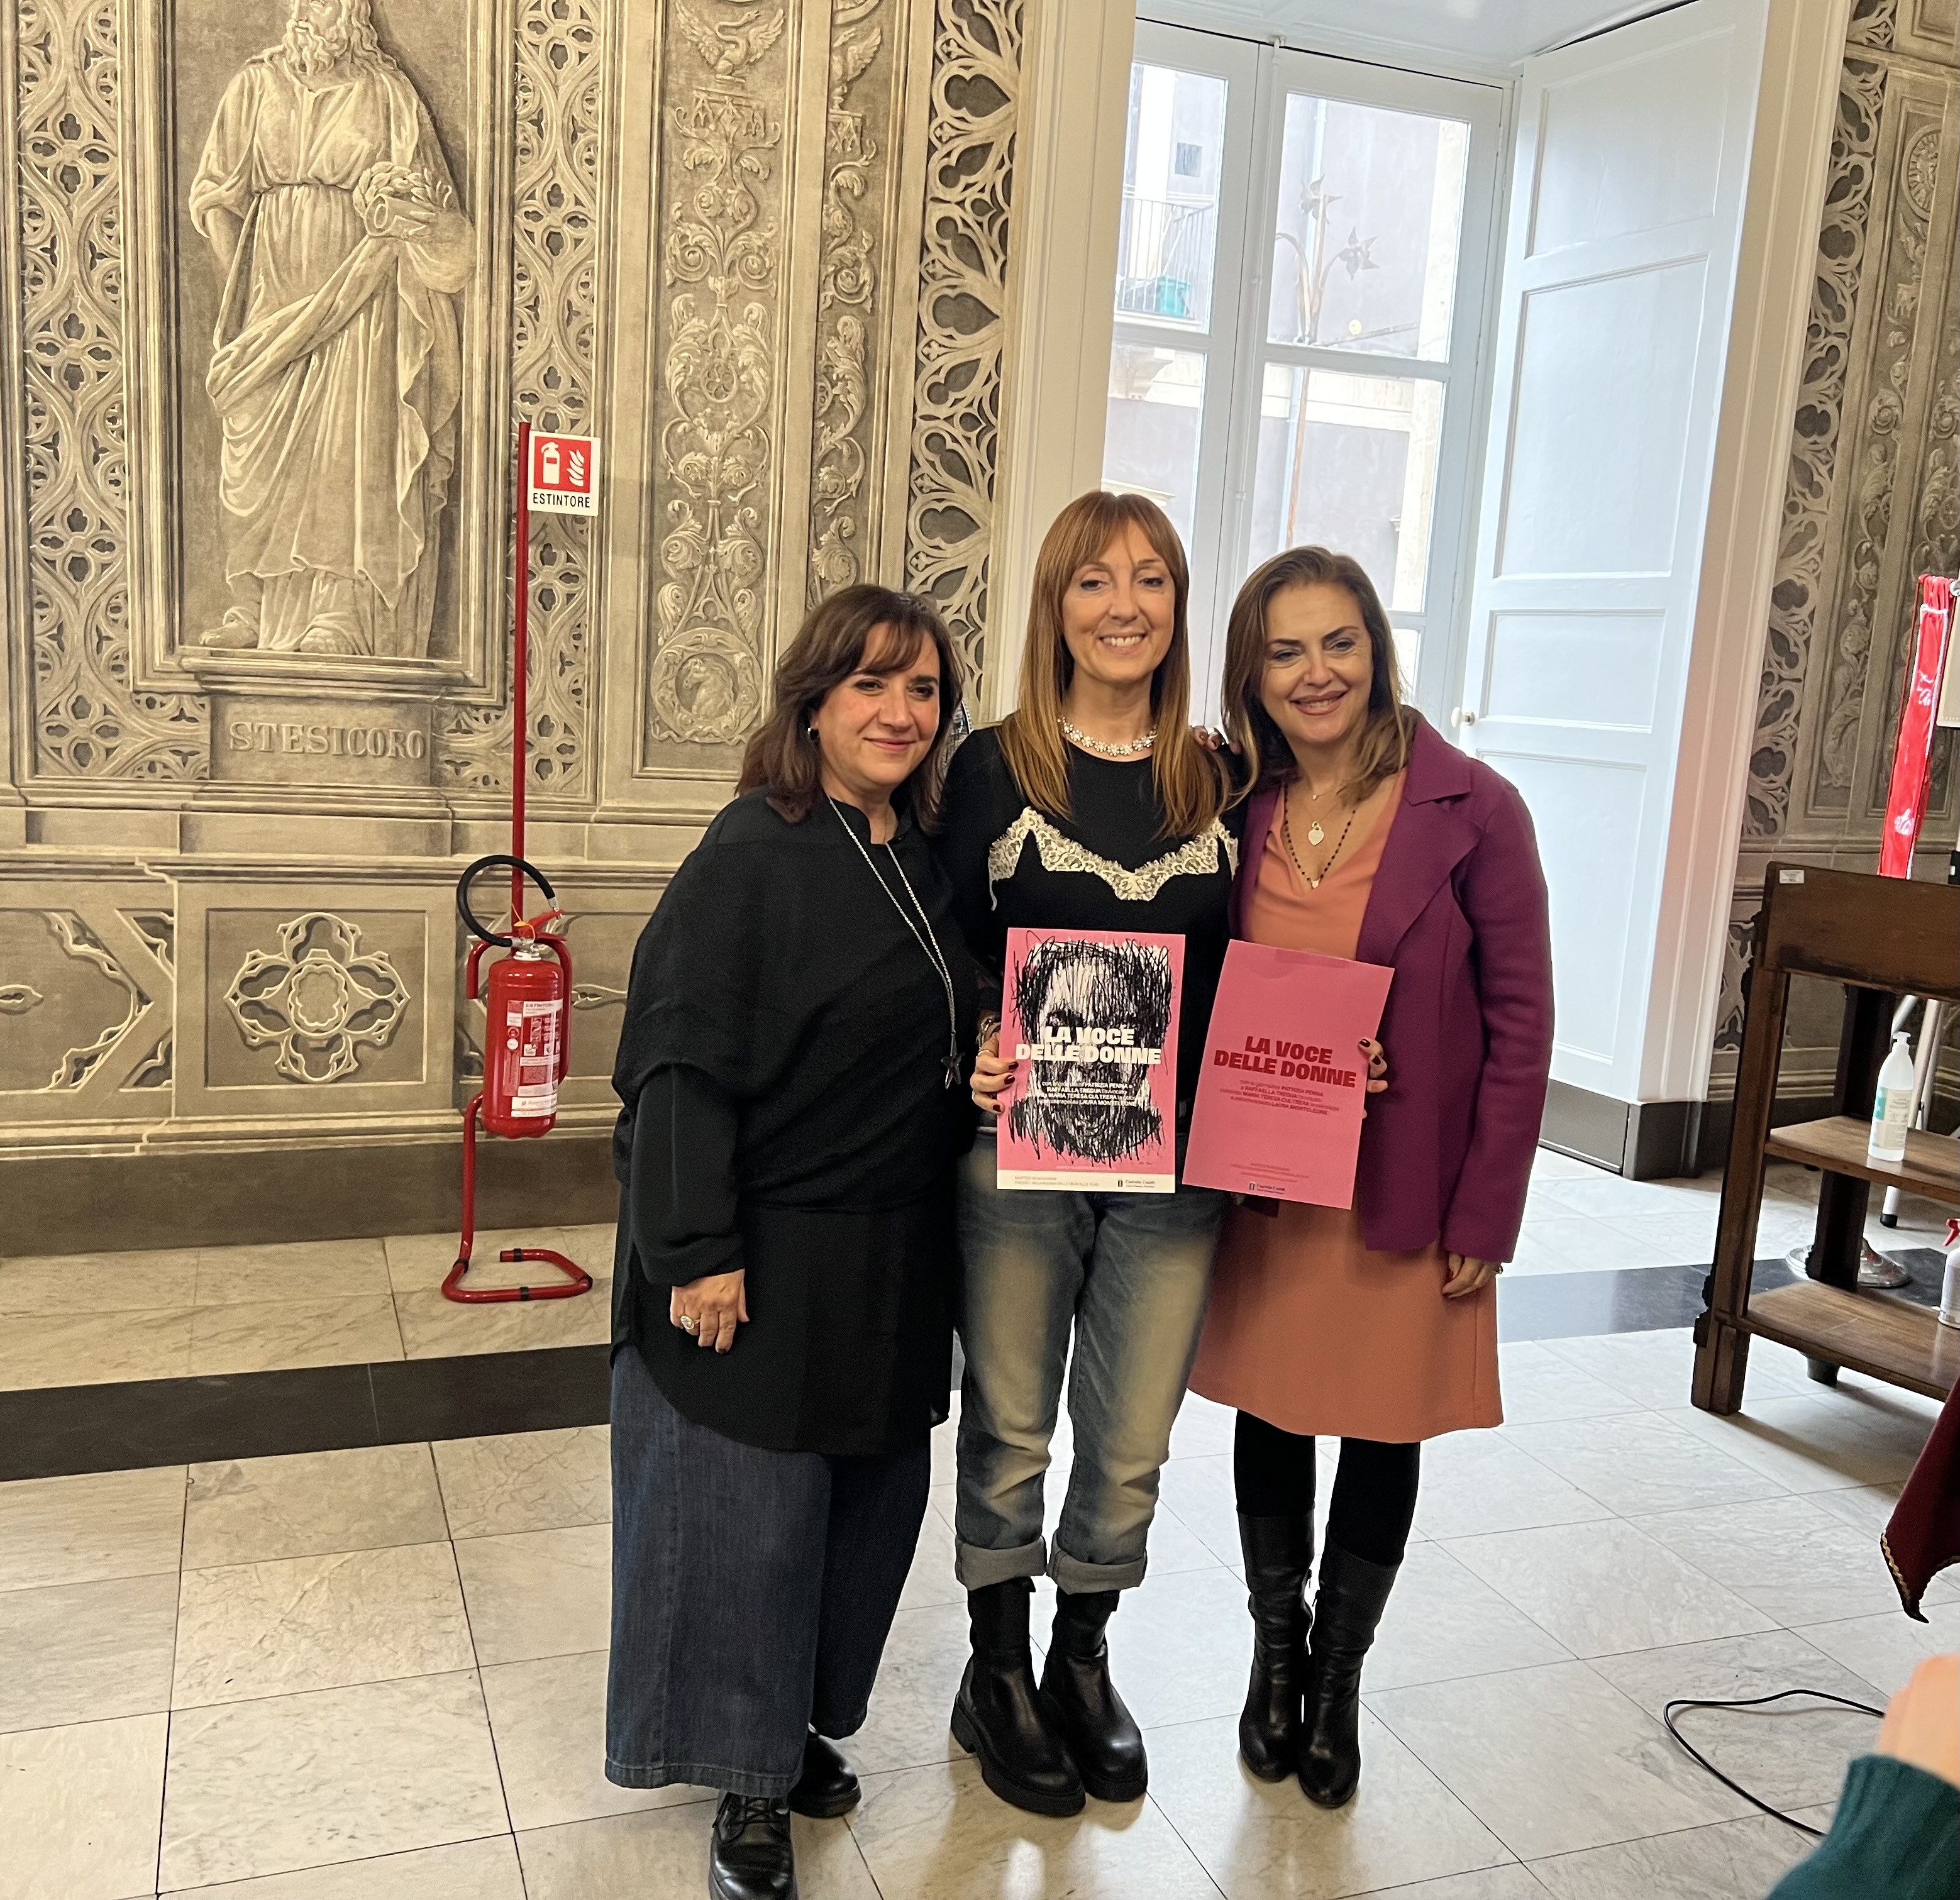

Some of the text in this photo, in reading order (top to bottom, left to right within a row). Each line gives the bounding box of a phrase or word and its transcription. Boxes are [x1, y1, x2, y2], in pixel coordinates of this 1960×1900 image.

[533, 492, 590, 508] ESTINTORE
[230, 721, 426, 758] STESICORO
[1044, 1026, 1134, 1045] LA VOCE
[1016, 1044, 1161, 1064] DELLE DONNE
[1245, 1036, 1332, 1065] LA VOCE
[1214, 1050, 1356, 1088] DELLE DONNE
